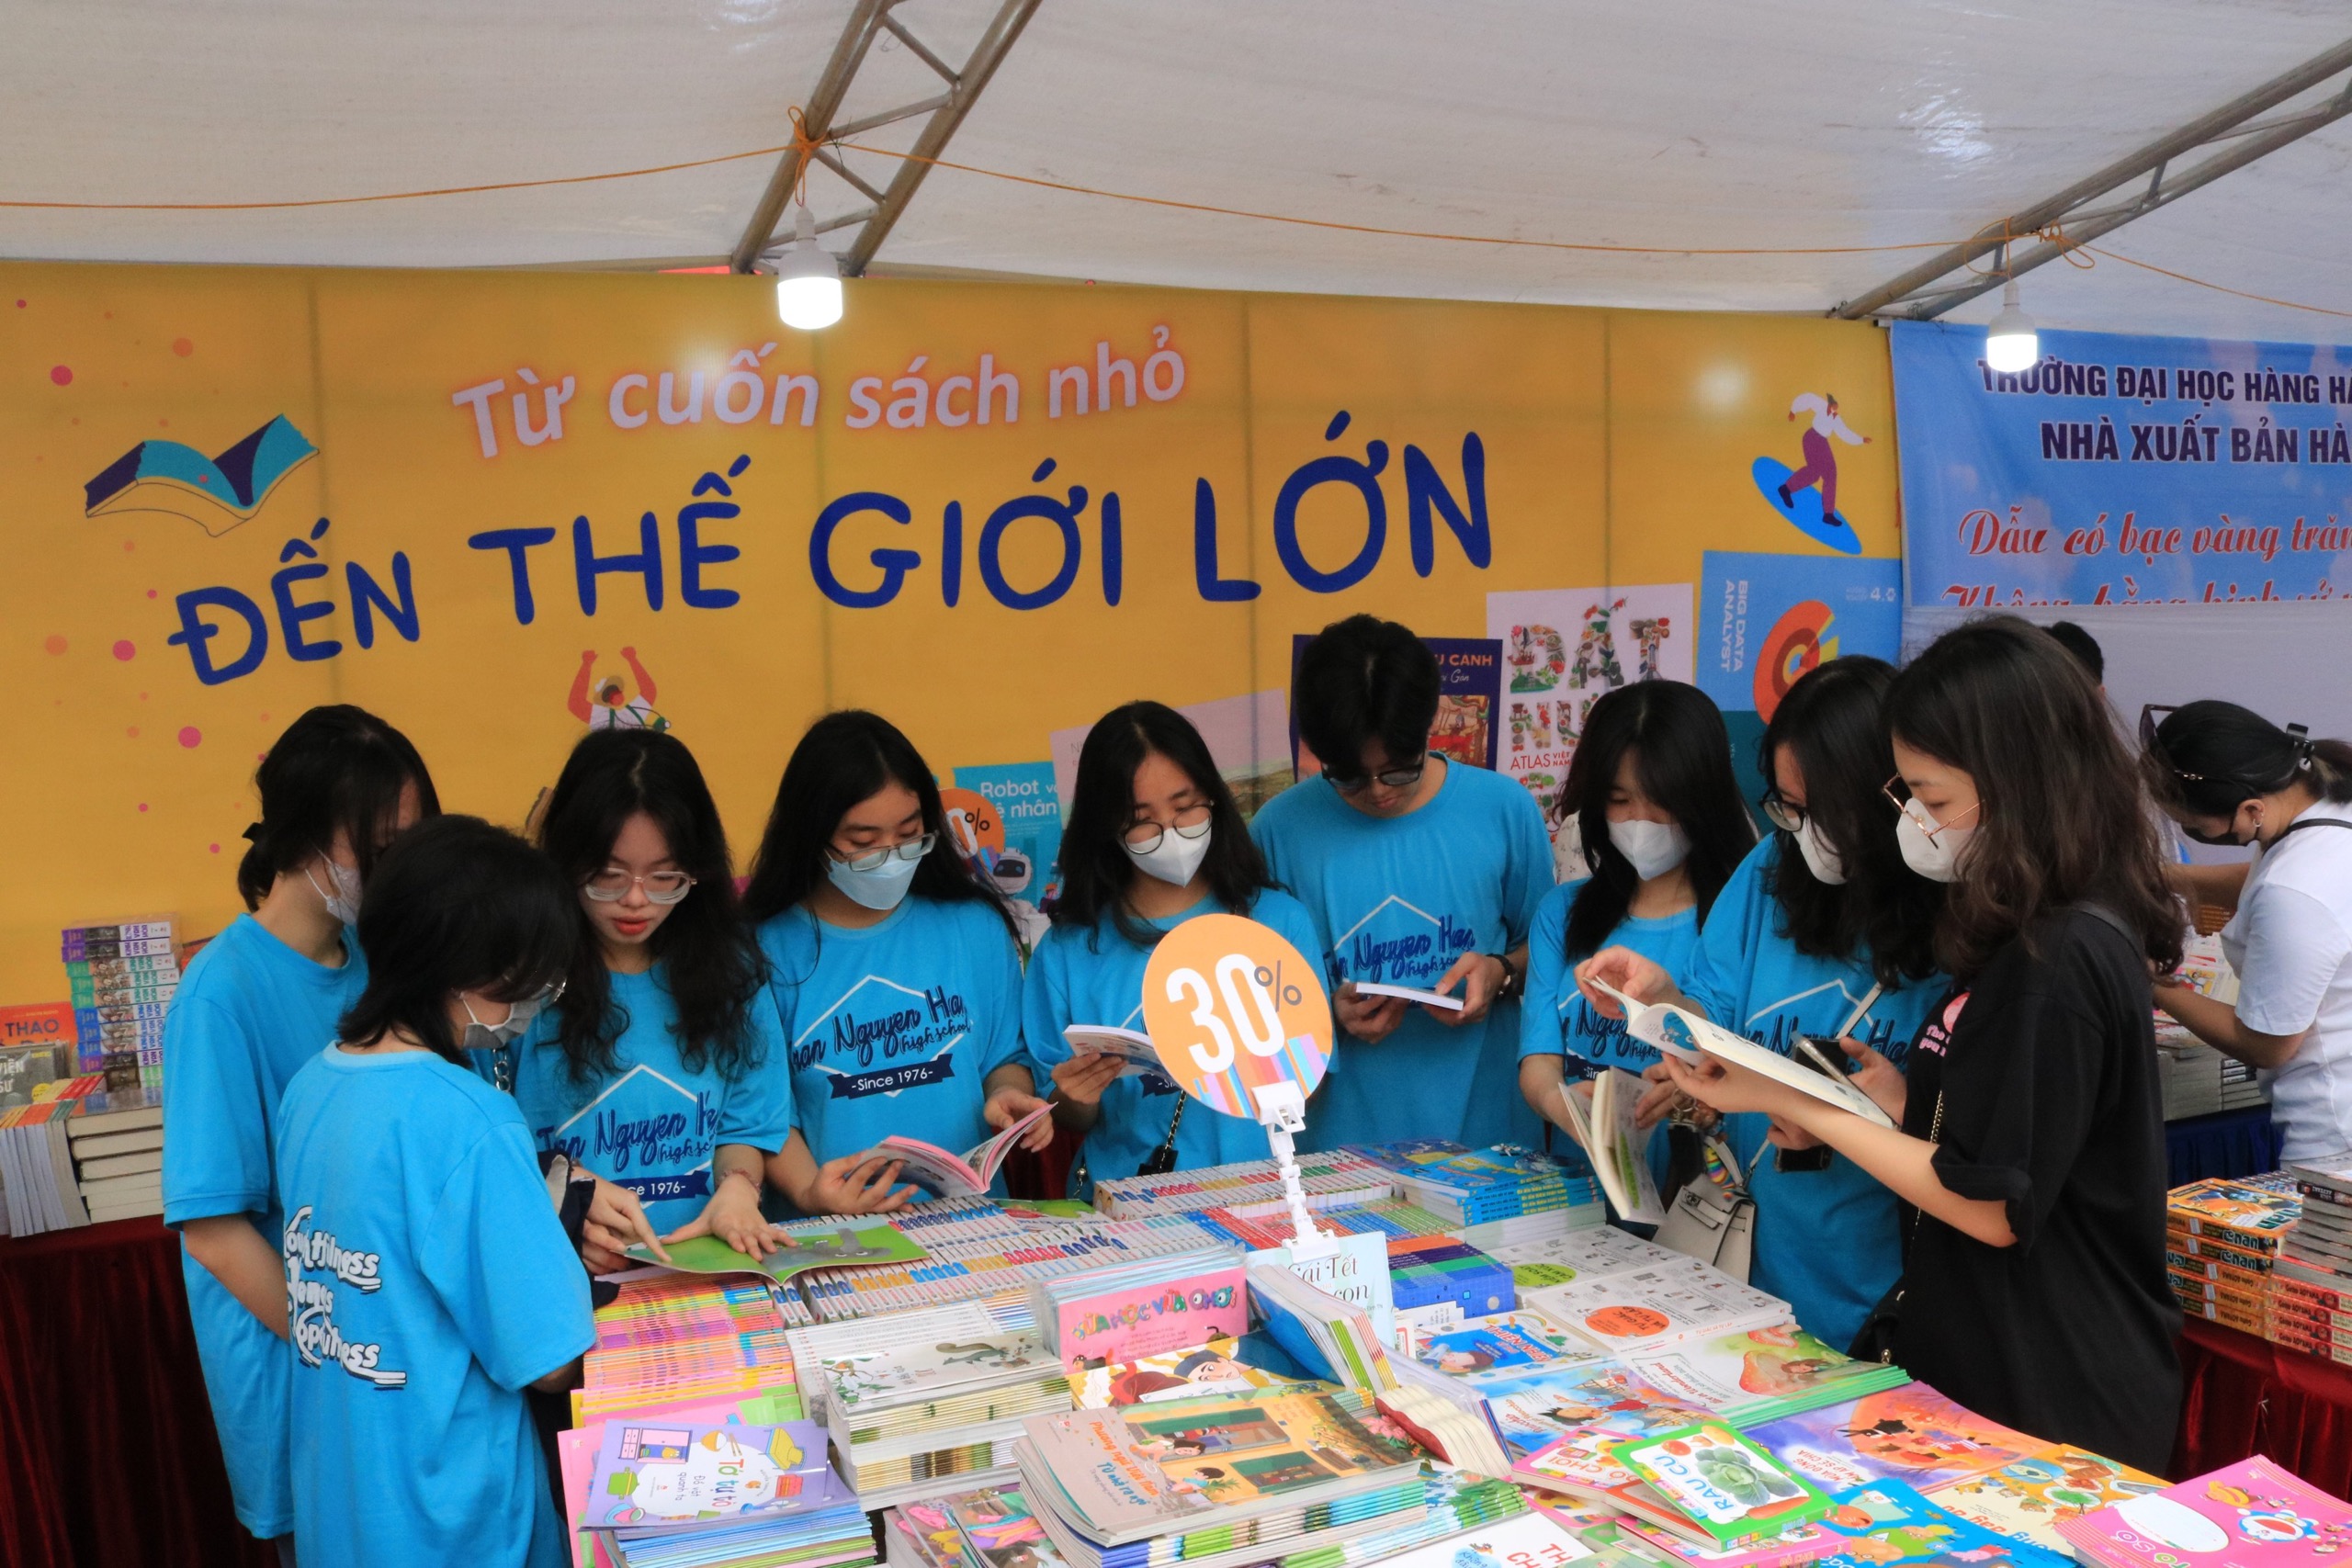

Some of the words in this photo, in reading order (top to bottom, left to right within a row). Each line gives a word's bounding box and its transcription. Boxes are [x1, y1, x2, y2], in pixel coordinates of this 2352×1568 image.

[452, 367, 576, 459] Từ
[608, 341, 820, 429] cuốn
[844, 354, 1020, 429] sách
[1048, 326, 1186, 419] nhỏ
[2116, 367, 2167, 407] ĐẠI
[2177, 369, 2234, 407] HỌC
[2245, 367, 2320, 404] HÀNG
[2041, 415, 2120, 461] NHÀ
[2131, 414, 2220, 462] XUẤT
[2231, 416, 2299, 463] BẢN
[167, 517, 420, 685] ĐẾN
[468, 455, 751, 626] THẾ
[809, 457, 1123, 610] GIỚI
[1195, 410, 1492, 602] LỚN
[1959, 506, 2049, 555] Dẫu
[2064, 513, 2109, 555] có
[2119, 512, 2183, 566] bạc
[2192, 513, 2281, 562] vàng
[1737, 580, 1748, 612] BIG
[1721, 580, 1736, 672] ANALYST
[1734, 616, 1747, 671] DATA
[1510, 753, 1551, 770] ATLAS
[980, 780, 1039, 797] Robot
[1012, 799, 1057, 818] nhân
[946, 807, 989, 858] 0%
[1354, 932, 1431, 984] Nguyen
[5, 1019, 60, 1037] THAO
[831, 1008, 922, 1066] Nguyen
[1165, 953, 1303, 1073] 30%
[1576, 998, 1631, 1058] Nguy
[852, 1074, 894, 1091] -Since
[898, 1068, 933, 1084] 1976-
[594, 1109, 687, 1173] Nguyen
[650, 1181, 686, 1194] 1976-
[1324, 1253, 1358, 1280] Tết
[1685, 1478, 1736, 1511] RAU
